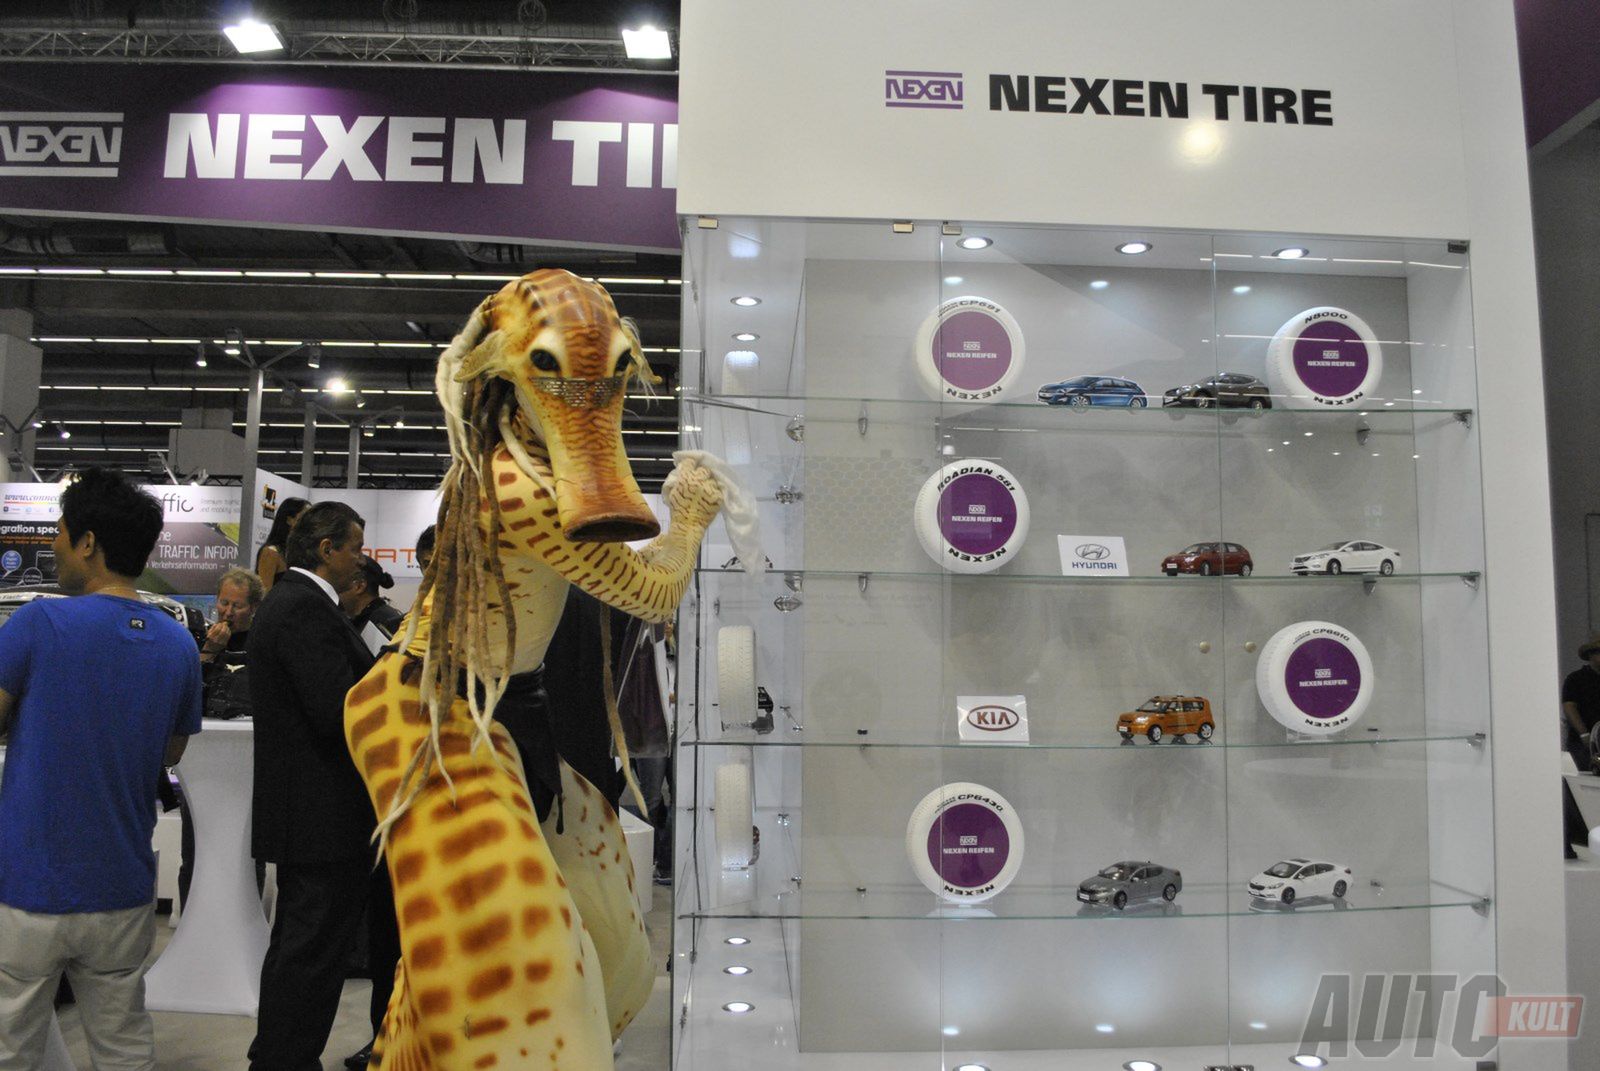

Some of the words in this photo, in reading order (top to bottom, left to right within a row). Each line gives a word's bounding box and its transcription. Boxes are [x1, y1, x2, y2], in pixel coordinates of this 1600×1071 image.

[885, 78, 963, 101] NEXEN
[989, 74, 1189, 119] NEXEN
[1202, 84, 1333, 126] TIRE
[164, 113, 527, 185] NEXEN
[946, 386, 1003, 400] NEXEN
[1314, 392, 1364, 405] NEXEN
[996, 475, 1021, 492] 581
[159, 545, 200, 559] TRAFFIC
[948, 547, 1007, 562] NEXEN
[977, 711, 1011, 725] KIA
[1305, 717, 1349, 728] NEXEN
[944, 884, 995, 896] NEXEN
